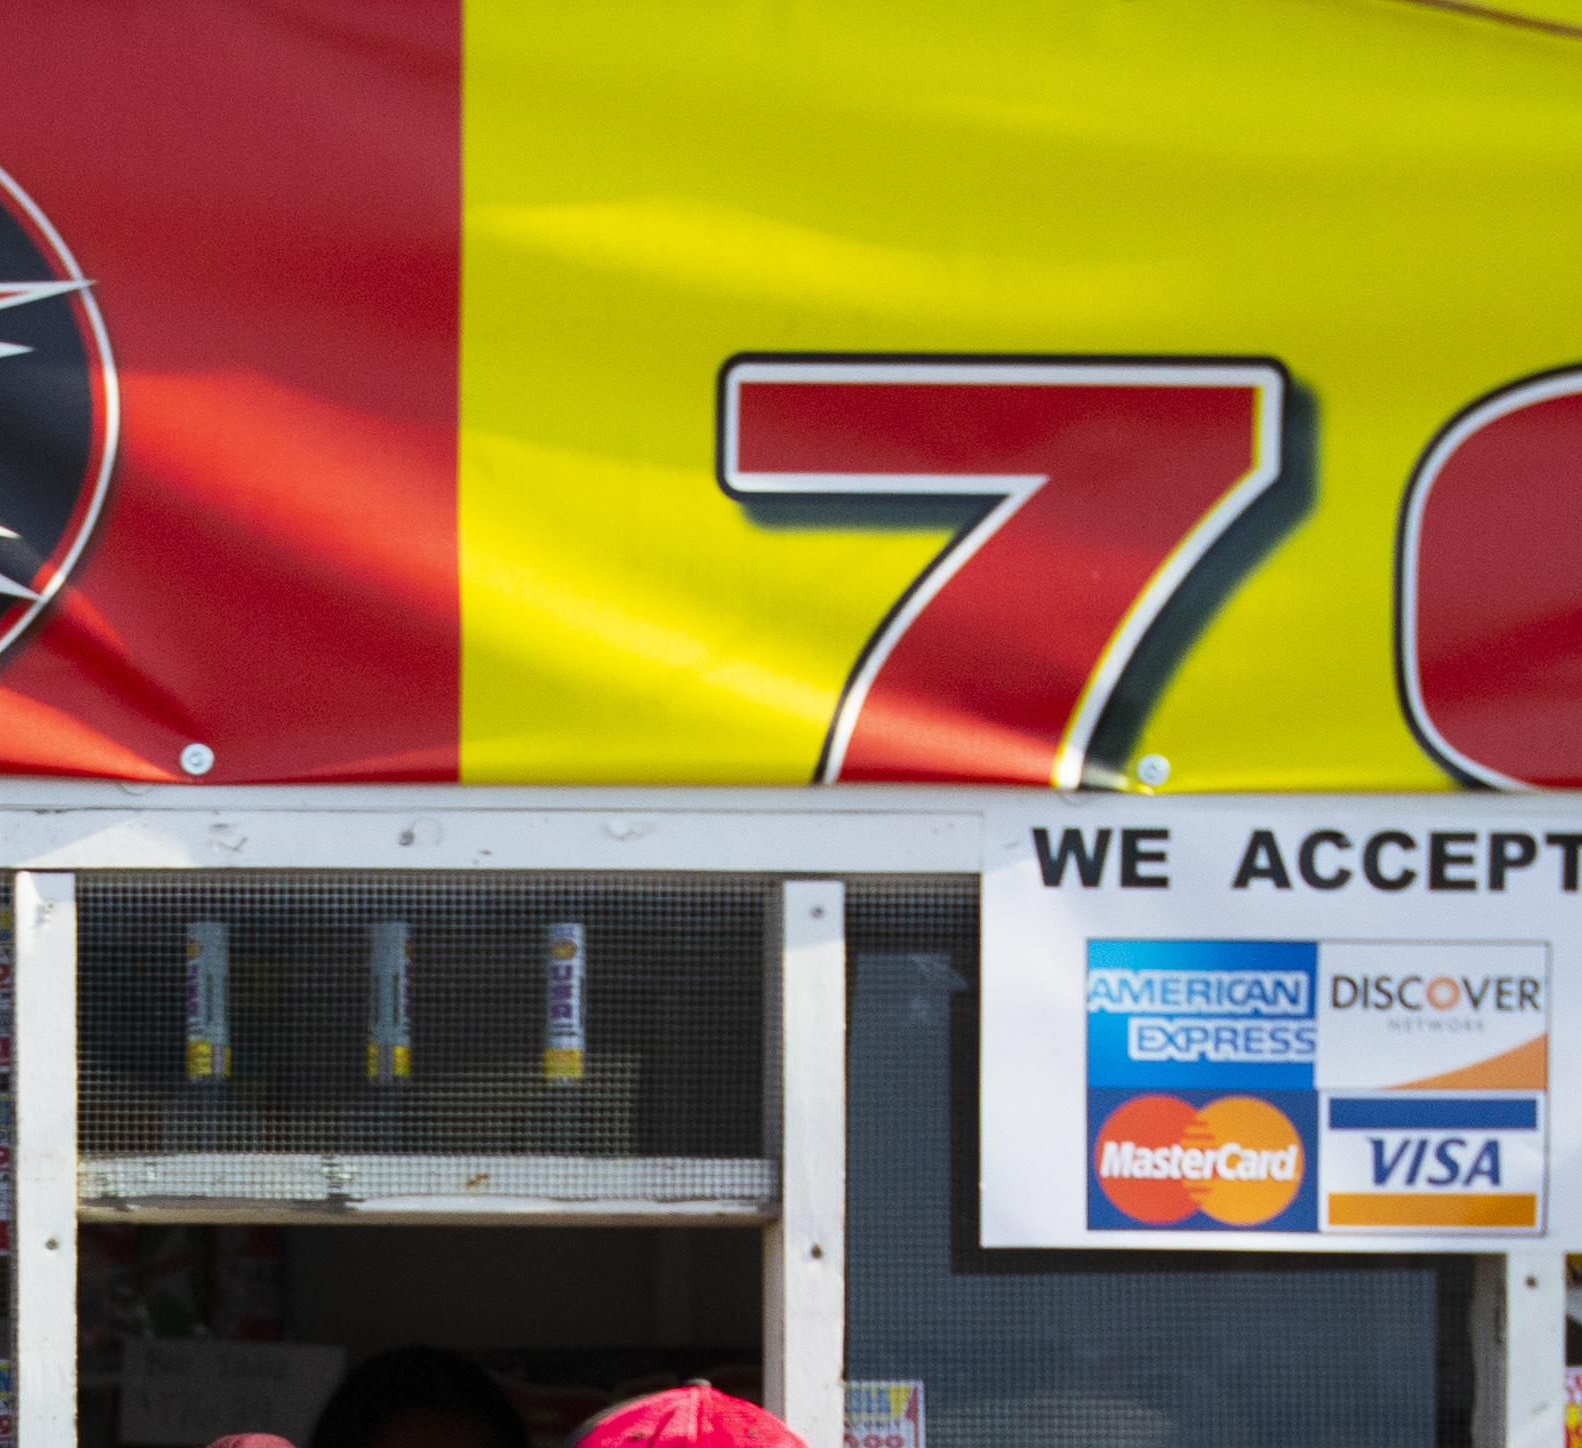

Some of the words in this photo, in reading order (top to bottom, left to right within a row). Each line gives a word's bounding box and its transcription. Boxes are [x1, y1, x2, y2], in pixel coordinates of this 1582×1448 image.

[1031, 826, 1170, 889] WE
[1088, 969, 1310, 1015] AMERICAN
[1331, 972, 1541, 1013] DISCOVER
[1128, 1017, 1318, 1062] EXPRESS
[1099, 1139, 1300, 1182] MasterCard
[1368, 1137, 1503, 1189] VISA
